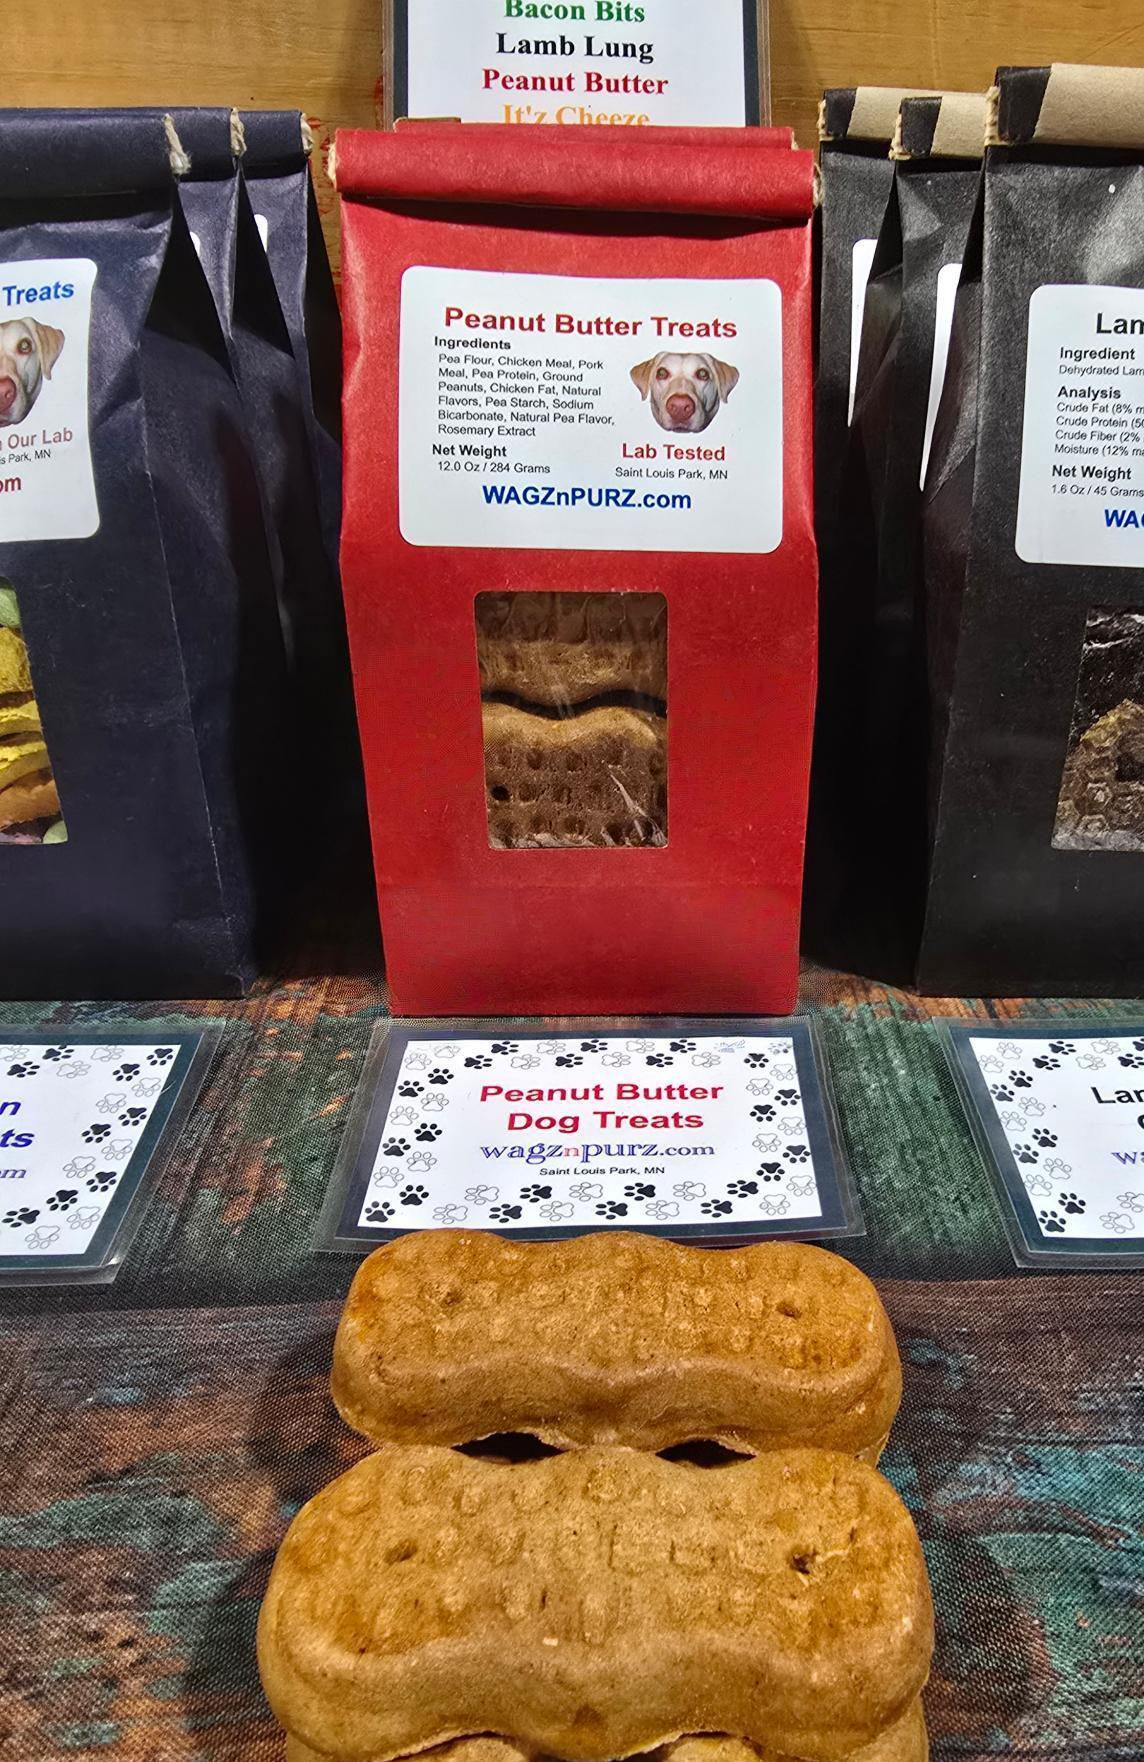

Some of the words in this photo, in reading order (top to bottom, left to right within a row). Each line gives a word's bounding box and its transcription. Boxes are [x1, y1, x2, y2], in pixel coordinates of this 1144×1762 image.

[505, 0, 585, 20] Bacon
[596, 0, 645, 22] Bits
[496, 33, 575, 56] Lamb
[584, 35, 653, 64] Lung
[482, 69, 575, 91] Peanut
[584, 72, 668, 94] Butter
[2, 281, 74, 306] Treats
[445, 307, 545, 332] Peanut
[555, 314, 642, 335] Butter
[651, 317, 738, 338] Treats
[434, 336, 511, 350] Ingredients
[1060, 347, 1135, 361] Ingredient
[438, 355, 460, 364] Pea
[464, 356, 494, 366] Flour,
[498, 356, 542, 367] Chicken
[546, 358, 575, 369] Meal,
[578, 359, 603, 369] Pork
[438, 368, 468, 381] Meal,
[472, 369, 493, 379] Pea
[497, 370, 539, 381] Protein,
[542, 371, 583, 382] Ground
[1059, 365, 1119, 376] Dehydrated
[438, 382, 487, 394] Peanuts,
[490, 383, 534, 394] Chicken
[538, 385, 559, 396] Fat,
[562, 386, 601, 396] Natural
[1058, 387, 1121, 399] Analysis
[438, 396, 482, 408] Flavors,
[485, 398, 507, 407] Pea
[510, 398, 549, 409] Starch,
[552, 399, 593, 409] Sodium
[1057, 403, 1088, 413] Crude
[1091, 404, 1109, 413] Fat
[1112, 404, 1133, 415] (8%
[438, 410, 507, 422] Bicarbonate,
[511, 412, 550, 422] Natural
[553, 413, 575, 423] Pea
[578, 413, 614, 425] Flavor,
[1056, 417, 1088, 427] Crude
[1091, 418, 1128, 427] Protein
[8, 434, 37, 449] Our
[42, 428, 72, 443] Lab
[438, 425, 494, 438] Rosemary
[498, 426, 536, 436] Extract
[1056, 430, 1087, 440] Crude
[1090, 431, 1116, 441] Fiber
[1120, 431, 1140, 443] (2%
[9, 452, 32, 464] Park,
[34, 450, 51, 460] MN
[432, 445, 455, 456] Net
[458, 445, 507, 459] Weight
[622, 444, 656, 459] Lab
[663, 445, 725, 461] Tested
[1055, 444, 1099, 455] Moisture
[1102, 445, 1128, 456] (12%
[438, 462, 460, 472] 12.0
[464, 462, 480, 472] Oz
[483, 462, 487, 473] /
[490, 463, 510, 473] 284
[514, 463, 550, 474] Grams
[616, 468, 643, 478] Saint
[646, 468, 675, 478] Louis
[678, 469, 706, 480] Park,
[709, 470, 728, 479] MN
[1052, 465, 1076, 478] Net
[1081, 466, 1131, 482] Weight
[483, 486, 692, 509] WAGZnPURZ.com
[1052, 485, 1066, 494] 1.6
[1070, 485, 1084, 494] Oz
[1087, 486, 1091, 495] /
[1094, 486, 1107, 496] 45
[480, 1084, 604, 1102] Peanut
[616, 1083, 723, 1101] Butter
[507, 1113, 579, 1133] Dog
[593, 1111, 704, 1129] Treats
[480, 1143, 715, 1164] wagznpurz.com
[539, 1167, 569, 1176] Saint
[574, 1167, 606, 1176] Louis
[610, 1166, 641, 1177] Park,
[644, 1166, 665, 1174] MN
